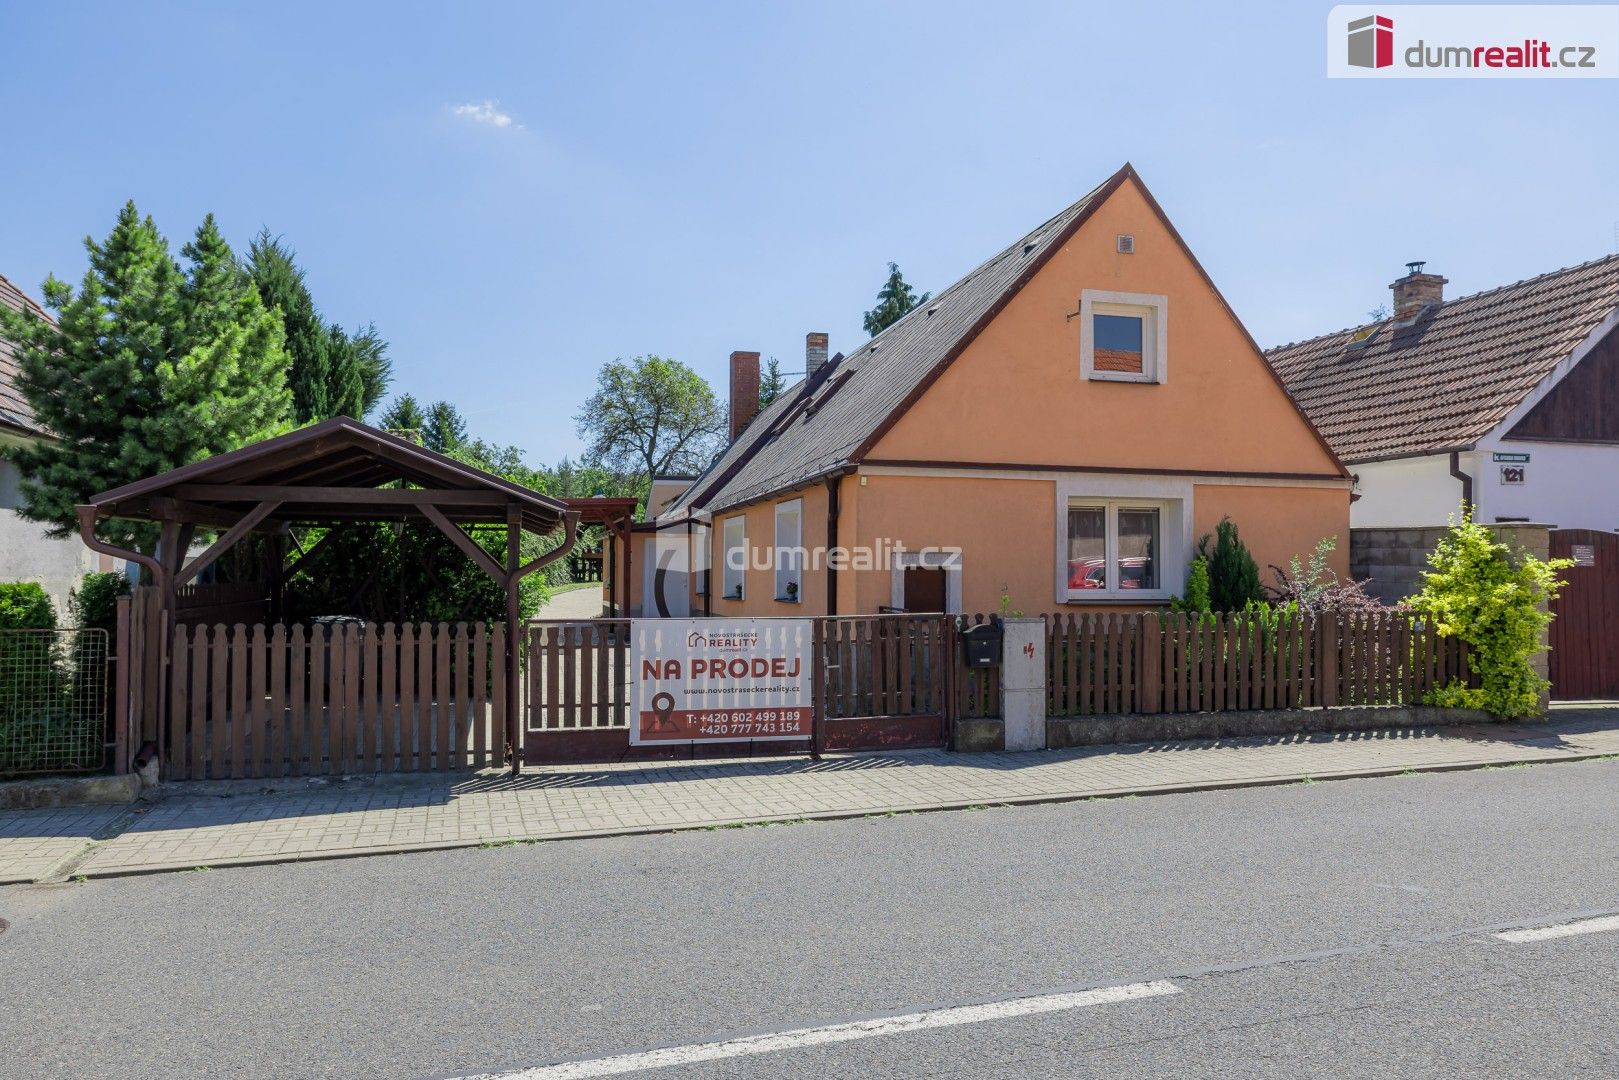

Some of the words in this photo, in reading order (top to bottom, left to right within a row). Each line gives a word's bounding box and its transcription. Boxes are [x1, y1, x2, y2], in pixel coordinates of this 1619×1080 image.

[709, 638, 758, 647] REALITY
[642, 659, 682, 681] NA
[690, 657, 801, 680] PRODEJ
[683, 684, 801, 695] www.novostraseckereality.cz
[686, 713, 697, 724] T:
[700, 712, 729, 723] +420
[731, 712, 753, 722] 602
[755, 711, 777, 721] 499
[779, 711, 801, 721] 189
[699, 724, 728, 735] +420
[731, 723, 752, 734] 777
[755, 723, 776, 733] 743
[779, 722, 801, 732] 154
